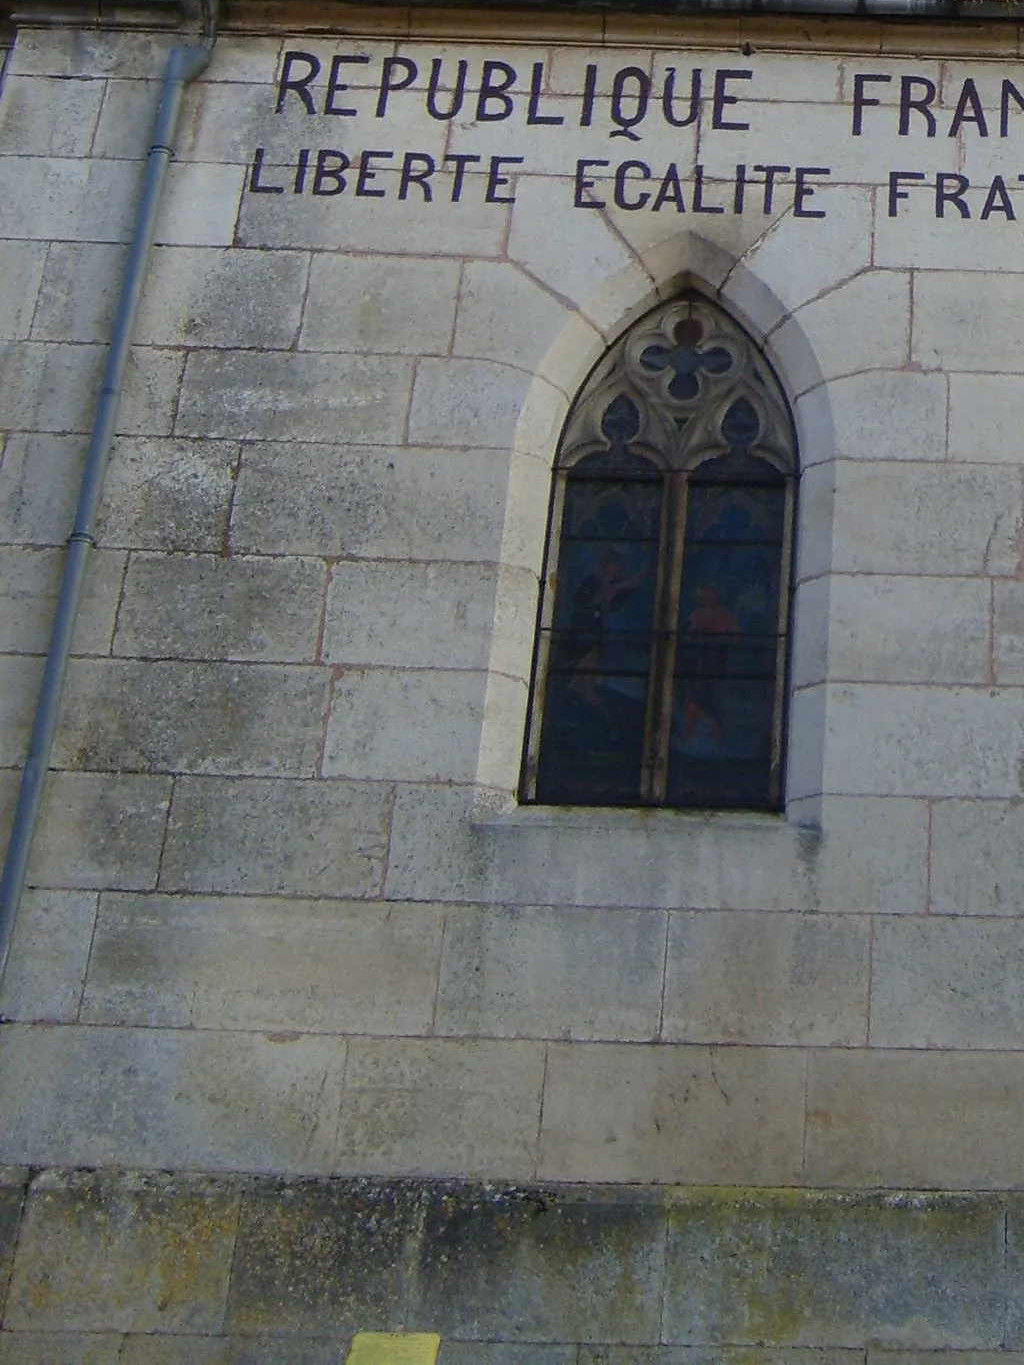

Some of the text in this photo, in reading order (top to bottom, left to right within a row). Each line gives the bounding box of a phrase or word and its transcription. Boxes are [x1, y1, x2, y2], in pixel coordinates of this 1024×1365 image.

[275, 50, 755, 142] REPUBLIQUE
[248, 147, 525, 204] LIBERTE
[573, 159, 831, 219] EGALITE
